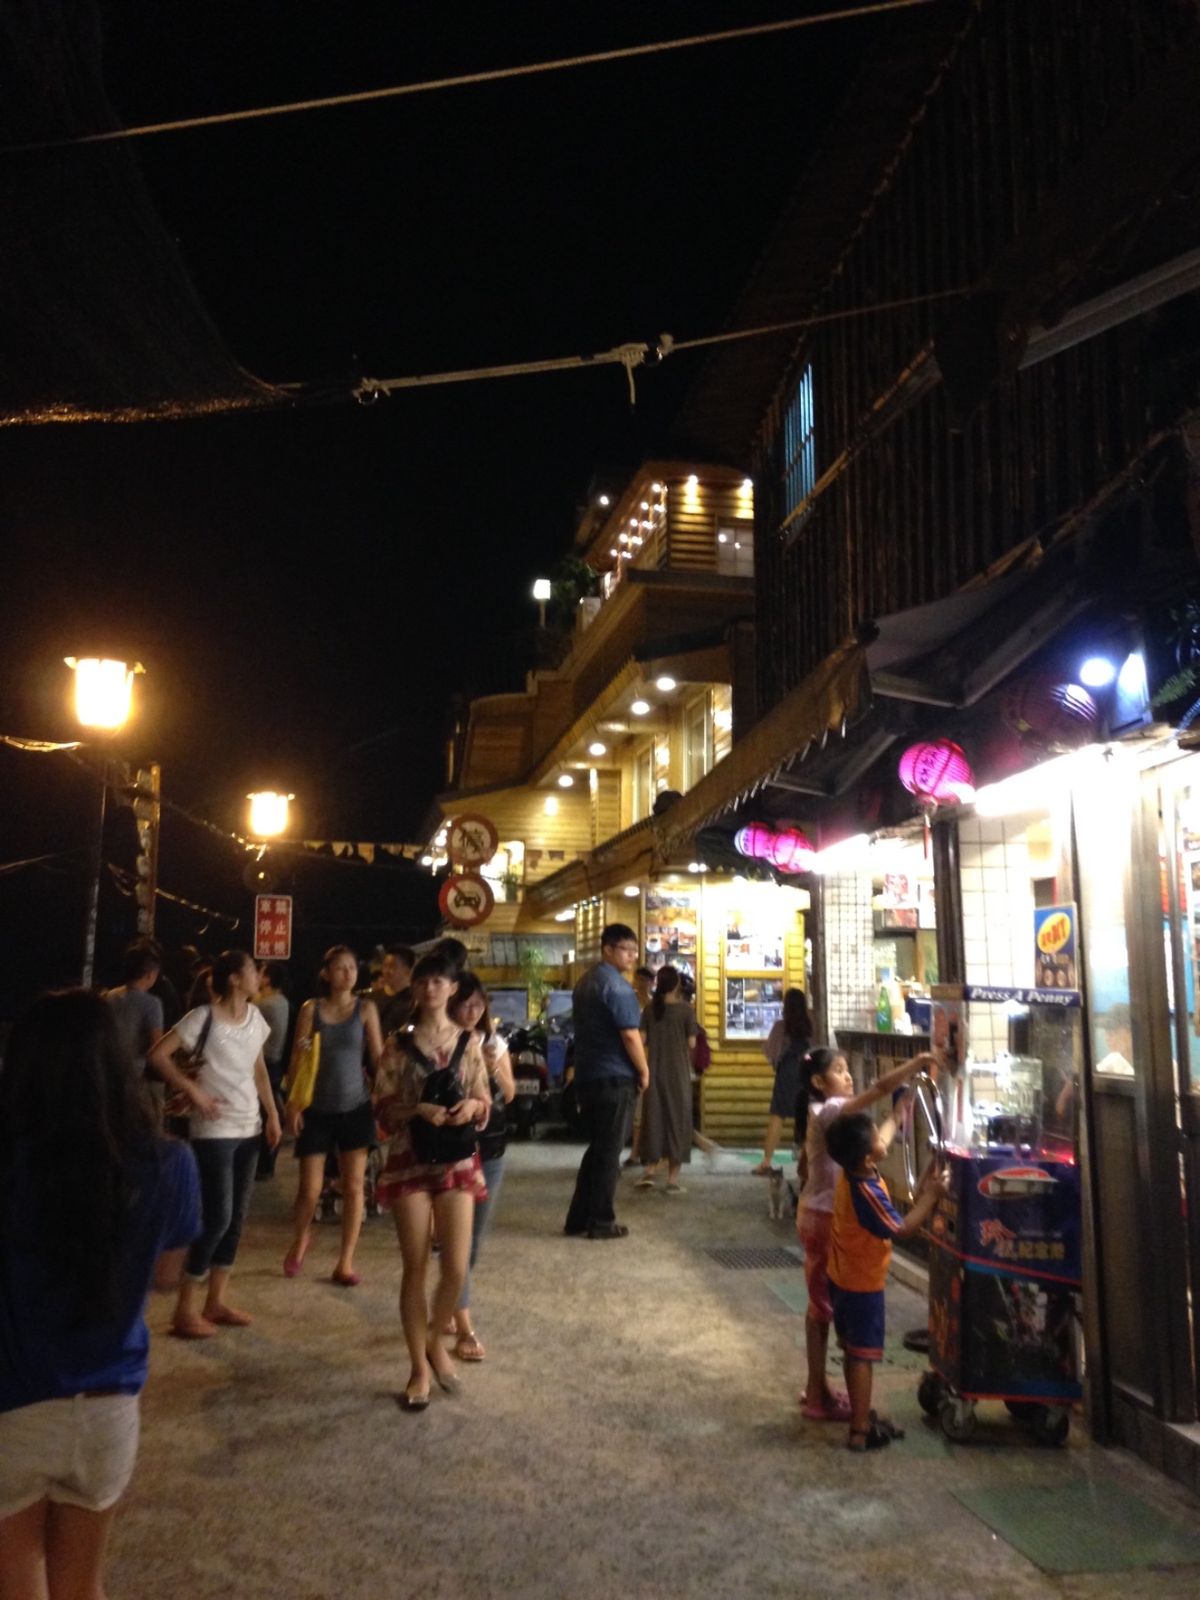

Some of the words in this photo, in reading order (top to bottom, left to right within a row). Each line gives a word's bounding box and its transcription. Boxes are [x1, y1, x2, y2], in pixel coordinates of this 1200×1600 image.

[970, 986, 1011, 1001] Press
[1011, 988, 1024, 1003] A
[1026, 990, 1074, 1006] Penny
